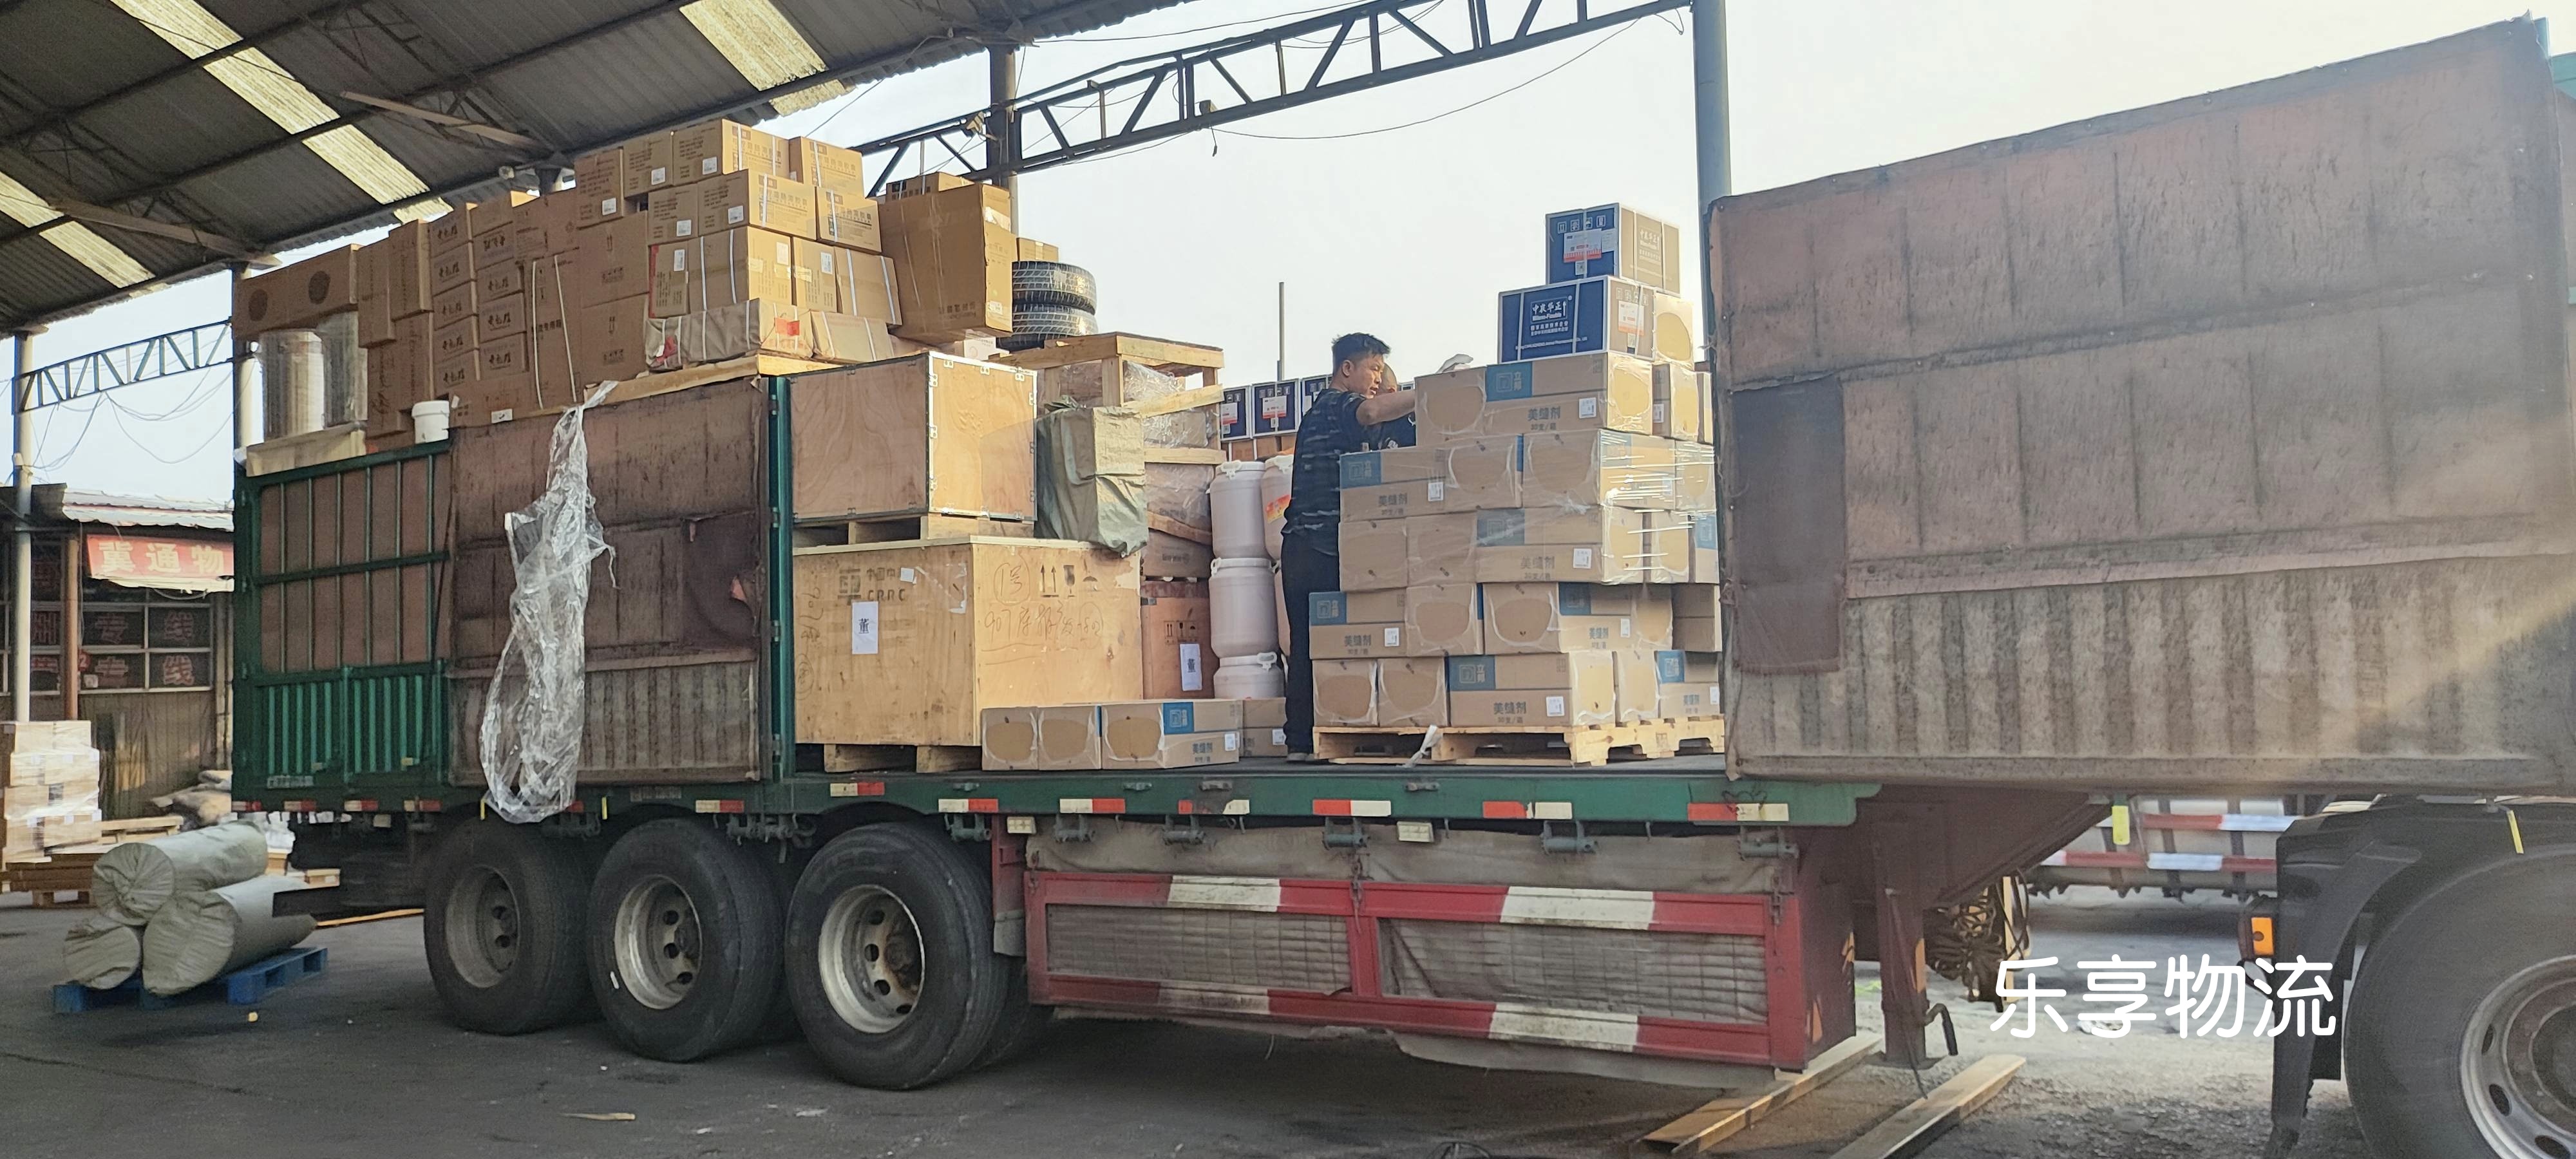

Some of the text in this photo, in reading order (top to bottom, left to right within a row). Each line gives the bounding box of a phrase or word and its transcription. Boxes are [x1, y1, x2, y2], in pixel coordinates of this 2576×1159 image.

[1528, 406, 1561, 421] 美缝剂
[1379, 493, 1408, 507] 美缝剂
[1520, 556, 1555, 569] 美缝剂
[1589, 627, 1609, 639] 美缝剂
[1344, 635, 1371, 646] 美缝剂
[1493, 701, 1527, 715] 美缝剂
[1193, 742, 1213, 755] 美缝剂
